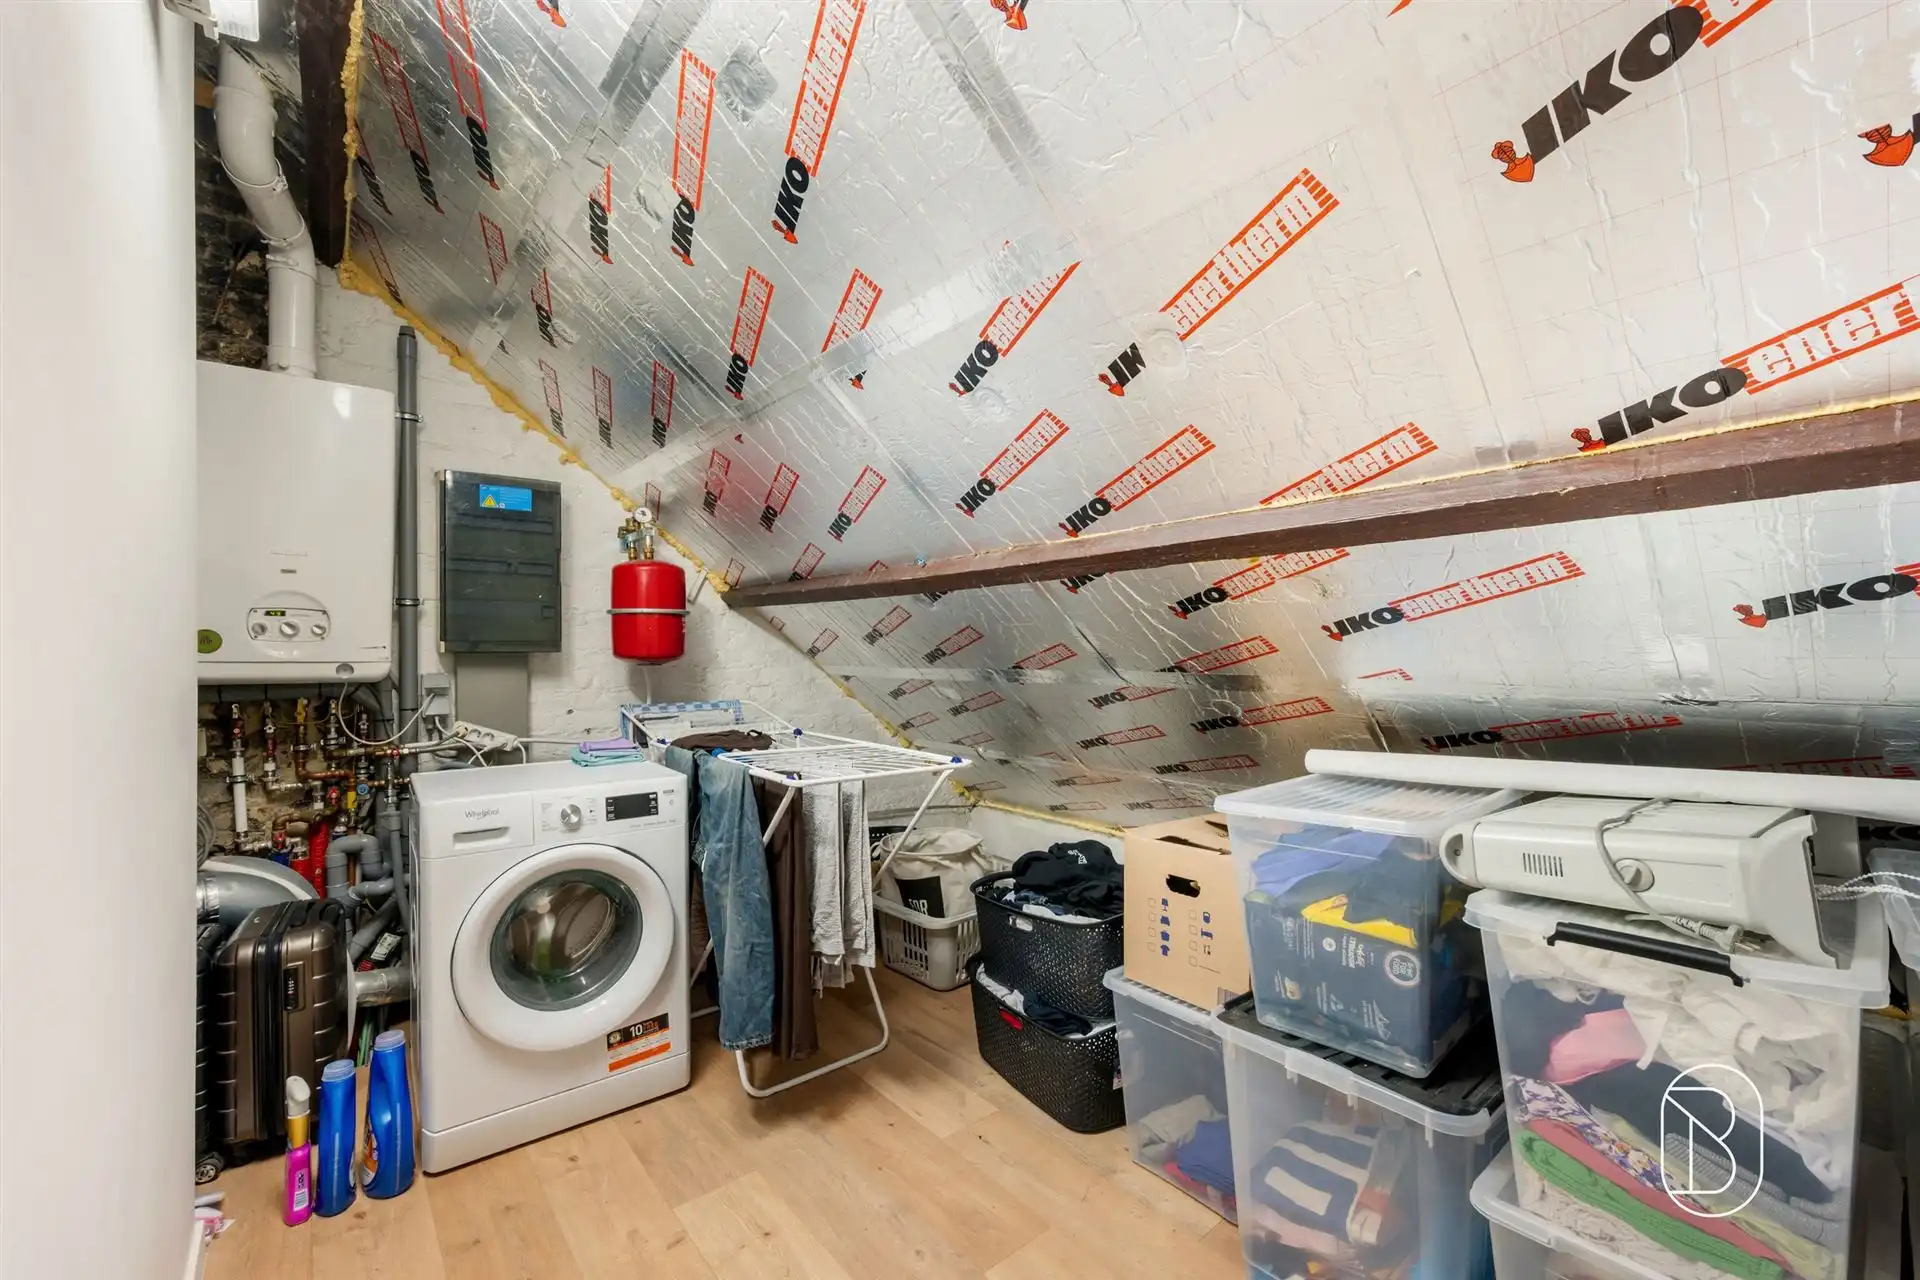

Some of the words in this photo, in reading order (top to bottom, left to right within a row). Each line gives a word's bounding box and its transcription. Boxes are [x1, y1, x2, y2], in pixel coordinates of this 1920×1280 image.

[1521, 5, 1704, 164] IKO
[774, 157, 809, 234] IKO
[588, 198, 608, 257] IKO
[671, 195, 695, 257] IKO
[1108, 342, 1146, 387] IK
[1165, 182, 1324, 332] enertherm
[725, 353, 749, 393] IKO
[956, 340, 999, 392] IKO
[1597, 366, 1747, 446] IKO
[960, 477, 996, 513] IKO
[985, 415, 1062, 487] enertherm
[1065, 498, 1112, 534] IKO
[1101, 431, 1205, 507] enertherm
[829, 512, 852, 540] IKO
[1176, 587, 1229, 615] IKO
[1333, 607, 1404, 636] IKO
[1396, 557, 1571, 618] enertherm
[1762, 574, 1918, 621] IKO
[1198, 716, 1240, 732] IKO
[1434, 730, 1500, 750] IKO
[629, 1023, 643, 1037] 10
